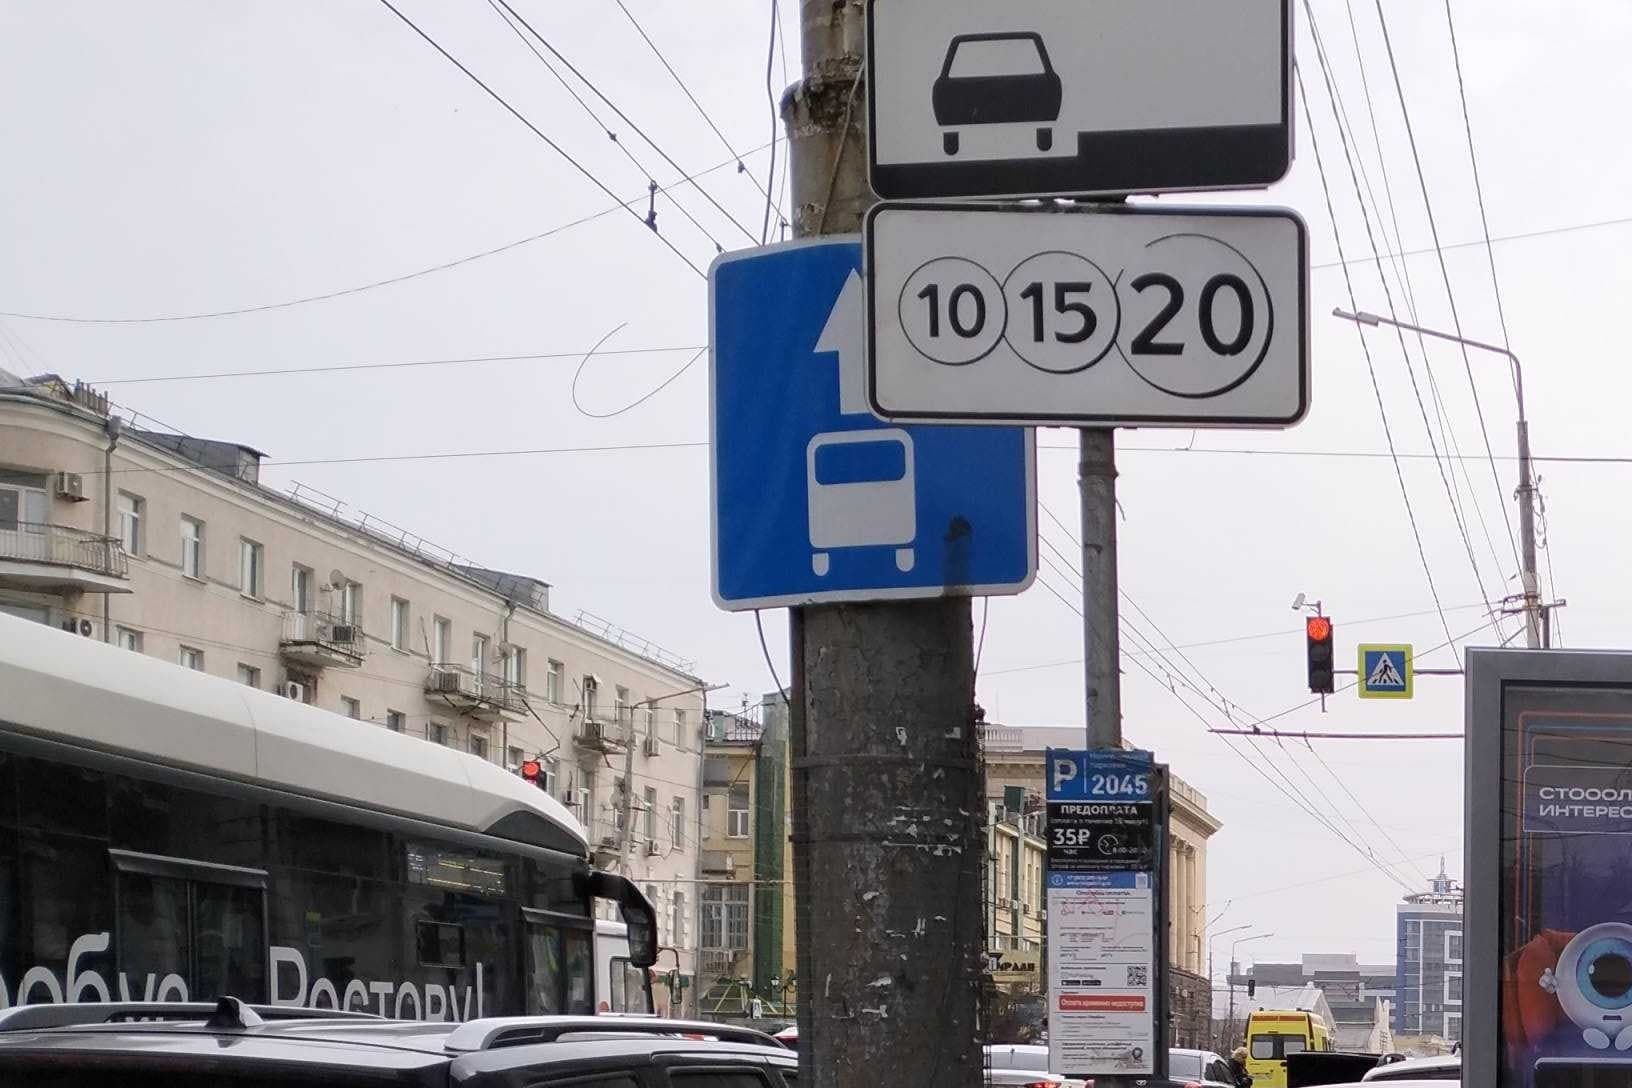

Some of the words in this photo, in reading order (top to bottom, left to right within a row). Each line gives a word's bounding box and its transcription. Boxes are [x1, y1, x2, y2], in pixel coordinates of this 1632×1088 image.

[916, 282, 987, 339] 10
[1019, 281, 1098, 344] 15
[1129, 272, 1255, 356] 20
[1091, 774, 1149, 795] 2045
